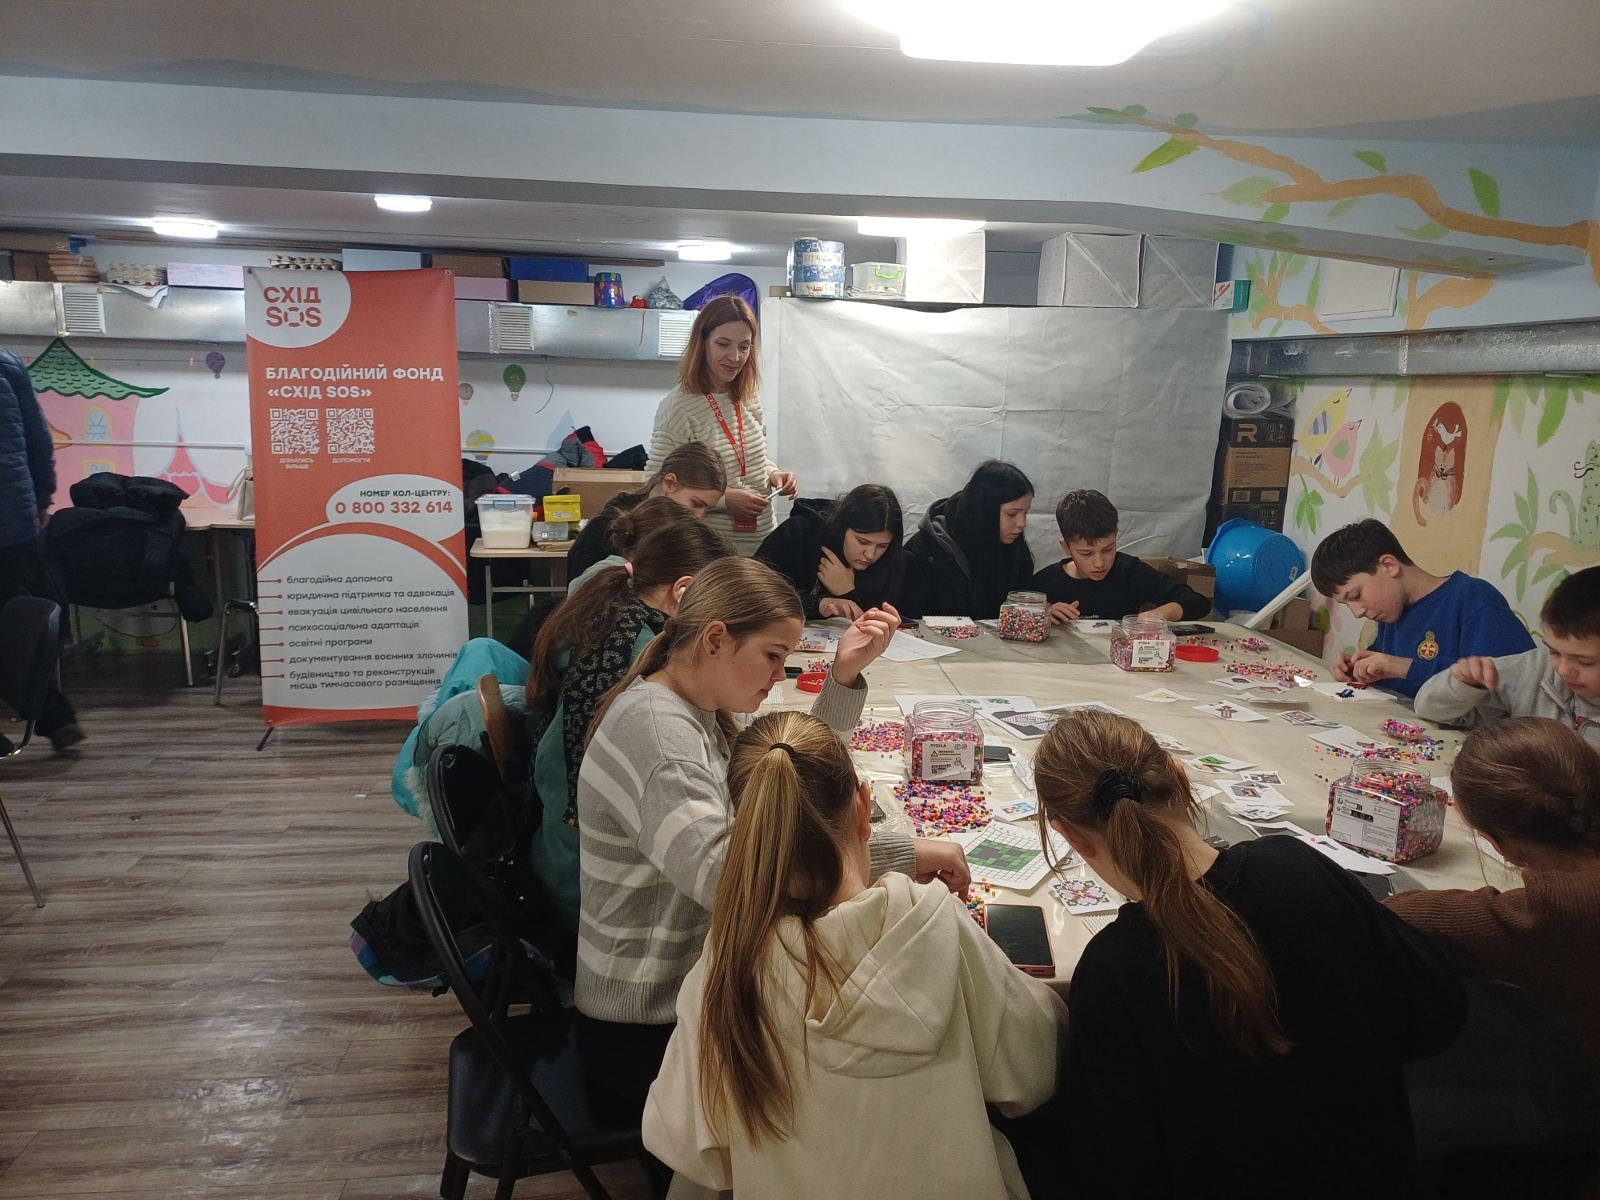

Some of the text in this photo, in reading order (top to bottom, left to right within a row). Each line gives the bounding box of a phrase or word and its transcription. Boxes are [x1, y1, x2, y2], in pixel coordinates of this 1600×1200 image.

[263, 286, 322, 304] СХІД
[265, 306, 322, 328] SOS
[265, 364, 444, 381] БЛАГОДІЙНИЙ ФОНД
[267, 385, 372, 399] «СХІД SOS»
[1236, 424, 1258, 442] R
[360, 489, 451, 498] НОМЕР КОЛ-ЦЕНТРУ:
[335, 500, 453, 514] 0 800 332 614
[286, 575, 393, 584] благодійна допомога
[287, 589, 455, 601] юридична підтримка та адвокація
[287, 605, 448, 617] евакуація цивільного населення
[288, 621, 420, 632] психосоціальна адаптація
[288, 638, 373, 648] освітні програми
[289, 651, 458, 664] документування воєнних злочинів
[289, 668, 350, 679] будівництво
[366, 668, 435, 678] реконструкція
[290, 678, 442, 690] місць тимчасового розміщення
